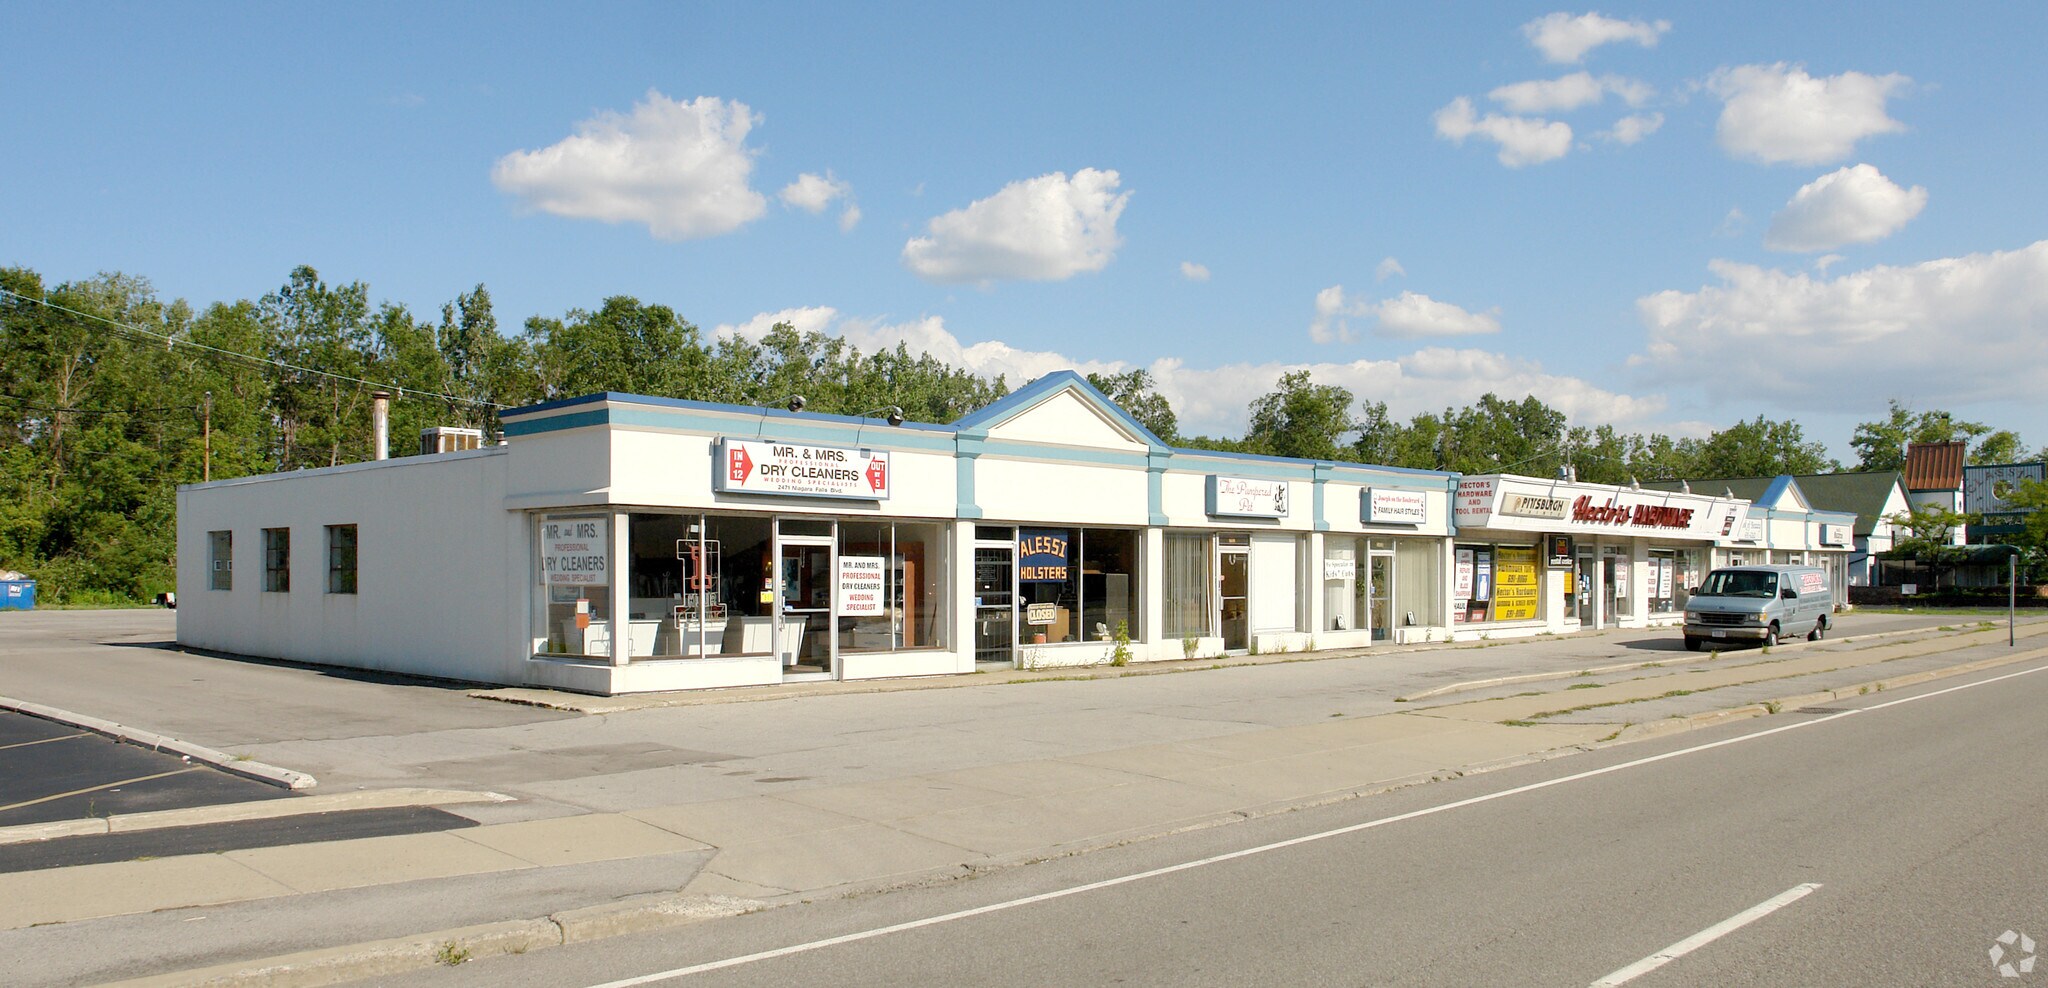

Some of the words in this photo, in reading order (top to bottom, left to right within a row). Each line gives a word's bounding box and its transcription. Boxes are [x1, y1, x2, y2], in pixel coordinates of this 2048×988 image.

[733, 451, 743, 461] IN
[773, 446, 798, 459] MR.
[802, 449, 812, 459] &
[815, 449, 848, 462] MRS.
[779, 458, 839, 468] PROFESSIONAL
[870, 461, 885, 471] OUT
[732, 470, 743, 479] 12
[760, 464, 788, 477] DRY
[791, 466, 859, 481] CLEANERS
[764, 477, 802, 485] WEDDING
[807, 479, 858, 488] SPECIALISTS
[875, 479, 881, 488] 5
[1460, 481, 1490, 489] HECTOR'S
[1967, 467, 2034, 494] CLASSI
[792, 485, 813, 493] Niagara
[1220, 480, 1235, 494] The
[1237, 481, 1272, 500] Pampered
[1457, 490, 1493, 498] HARDWARE
[1239, 498, 1253, 511] Pet
[1521, 497, 1564, 511] PITTSBURGH
[1405, 508, 1420, 516] STYLES
[1631, 503, 1695, 529] HARDWARE
[546, 524, 561, 539] MR.
[576, 523, 598, 538] MRS.
[554, 543, 589, 552] PROFESSIONAL
[1020, 536, 1068, 559] ALESSI
[561, 556, 604, 571] CLEANERS
[842, 572, 881, 580] PROFESSIONAL
[1020, 566, 1067, 580] HOLSTERS
[842, 582, 853, 590] DRY
[846, 603, 876, 611] SPECIALIST
[1029, 609, 1055, 621] CLOSED
